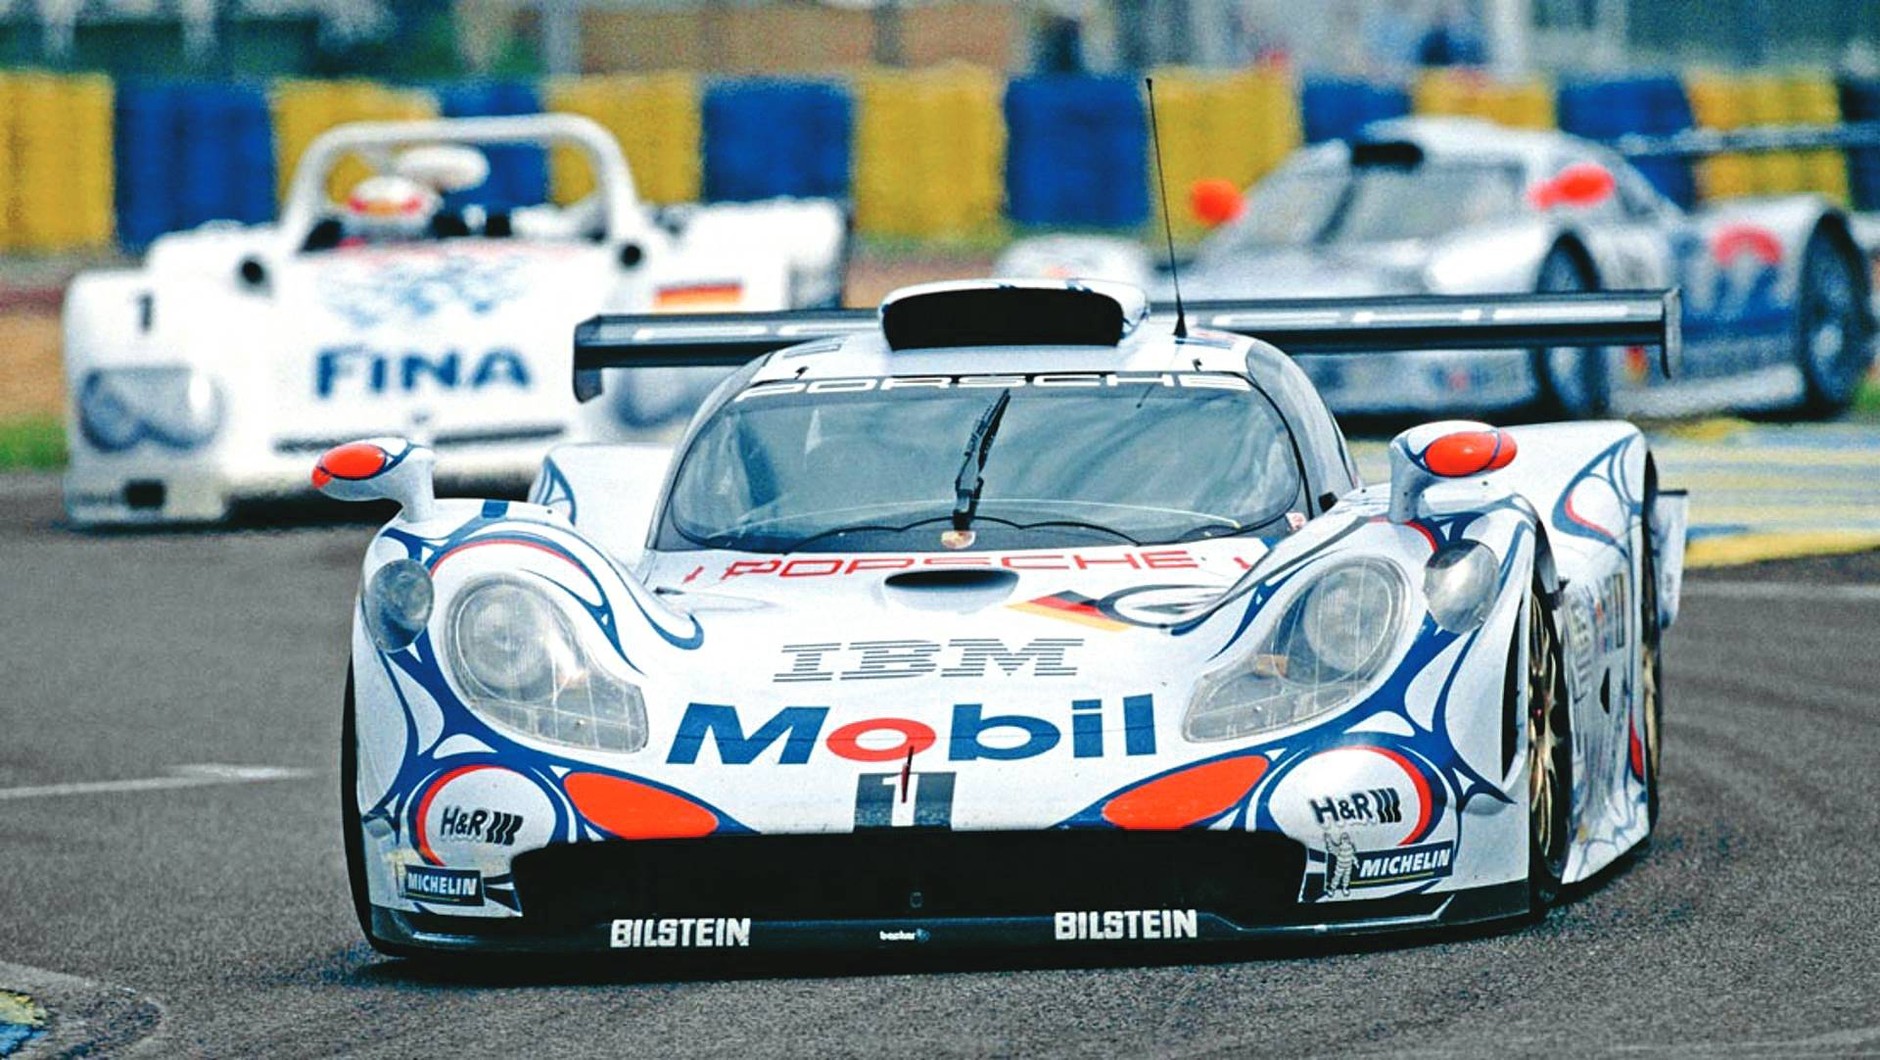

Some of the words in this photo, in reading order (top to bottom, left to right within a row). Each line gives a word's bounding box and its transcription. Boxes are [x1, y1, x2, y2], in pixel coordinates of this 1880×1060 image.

[314, 345, 532, 398] FINA
[734, 372, 1252, 403] PORSCHE
[773, 638, 1085, 683] IBM
[666, 693, 1157, 765] Mobil
[882, 772, 920, 828] 1
[1310, 792, 1374, 825] H&R
[440, 806, 488, 836] H&R
[1359, 847, 1452, 879] MICHELIN
[407, 872, 478, 896] MICHELIN
[610, 917, 752, 948] BILSTEIN
[1054, 909, 1198, 941] BILSTEIN
